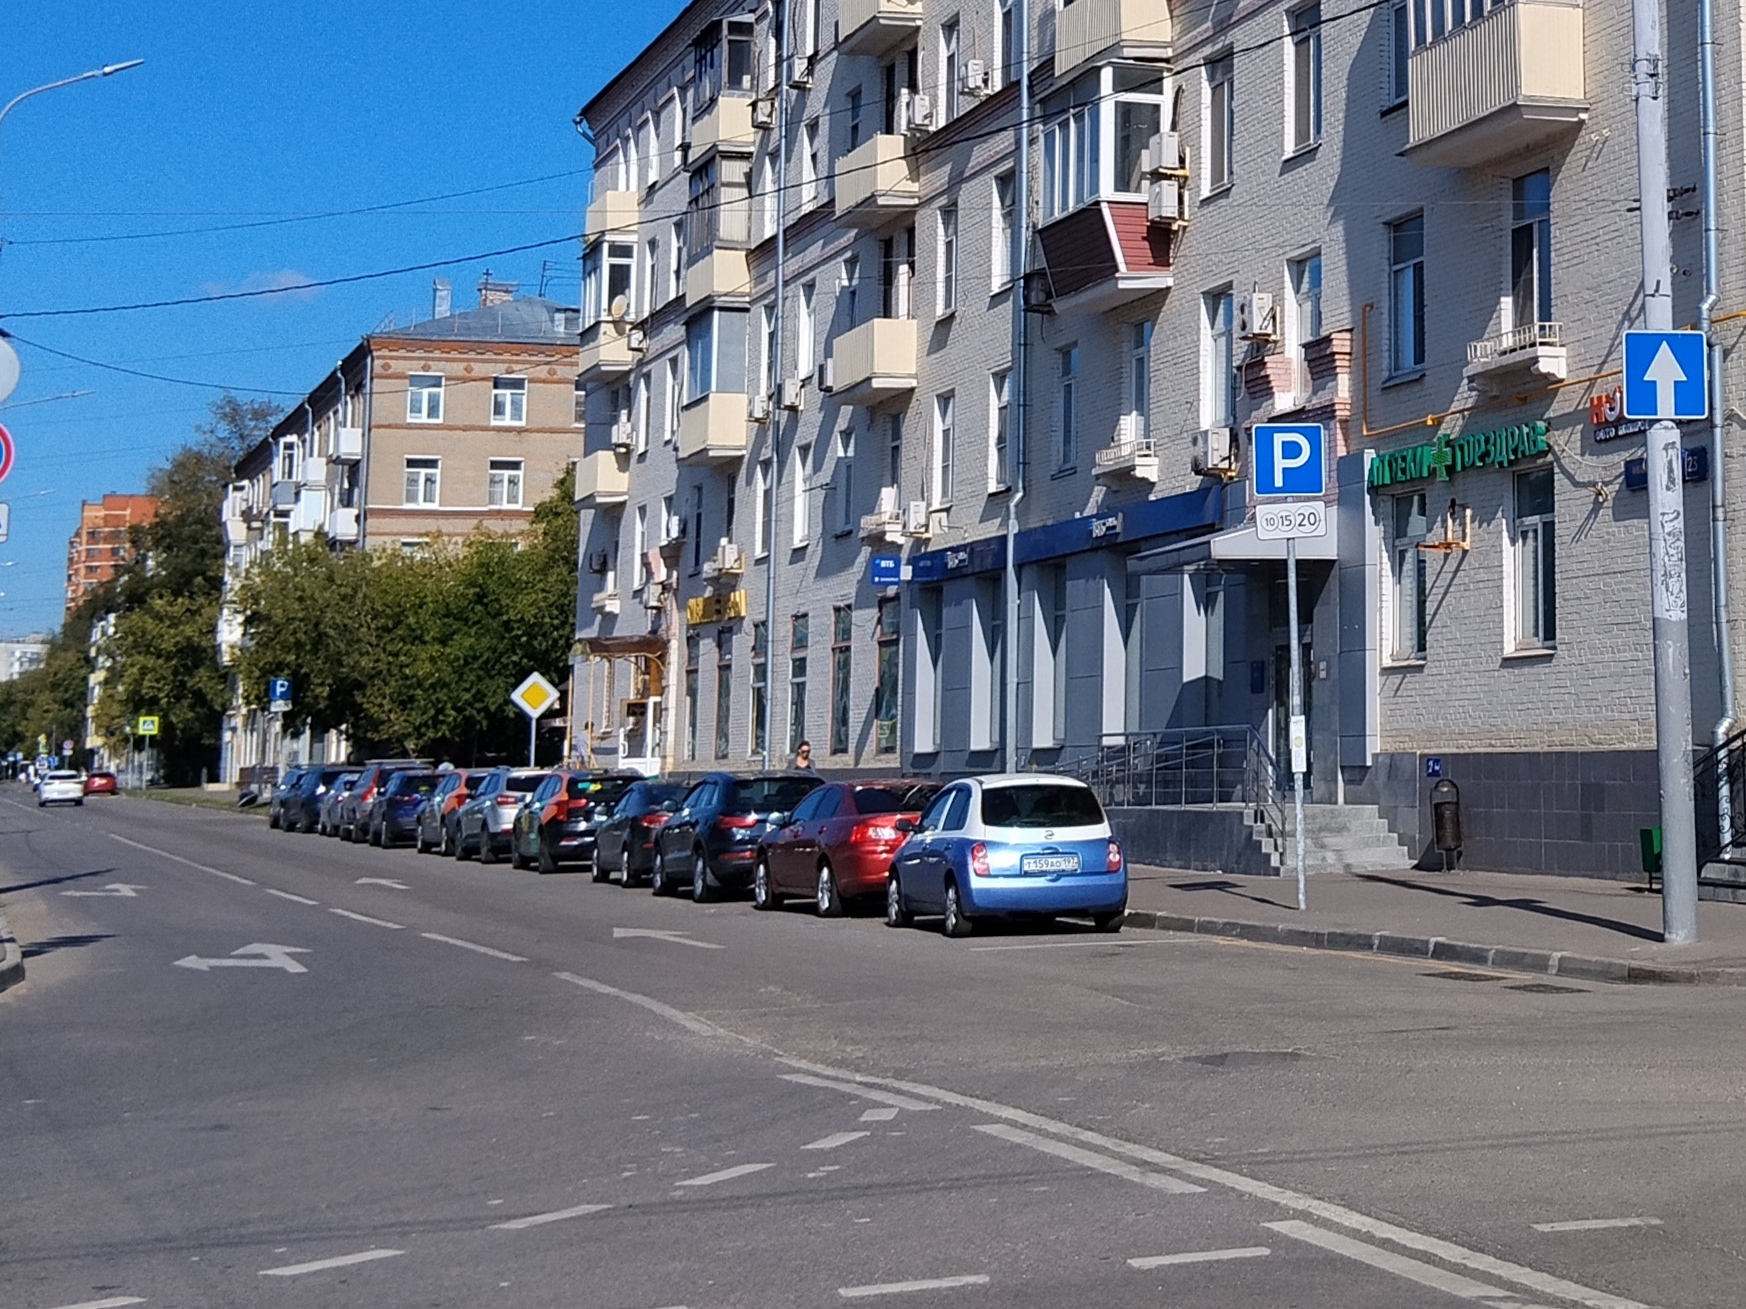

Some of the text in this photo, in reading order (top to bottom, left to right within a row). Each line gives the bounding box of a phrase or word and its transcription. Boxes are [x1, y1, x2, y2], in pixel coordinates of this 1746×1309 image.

[1273, 432, 1311, 488] P
[1367, 420, 1549, 488] АПТЕКИ ГОРЗДРАВ
[1264, 511, 1317, 527] 10 15 20
[880, 560, 895, 568] ВТБ
[276, 680, 289, 696] P
